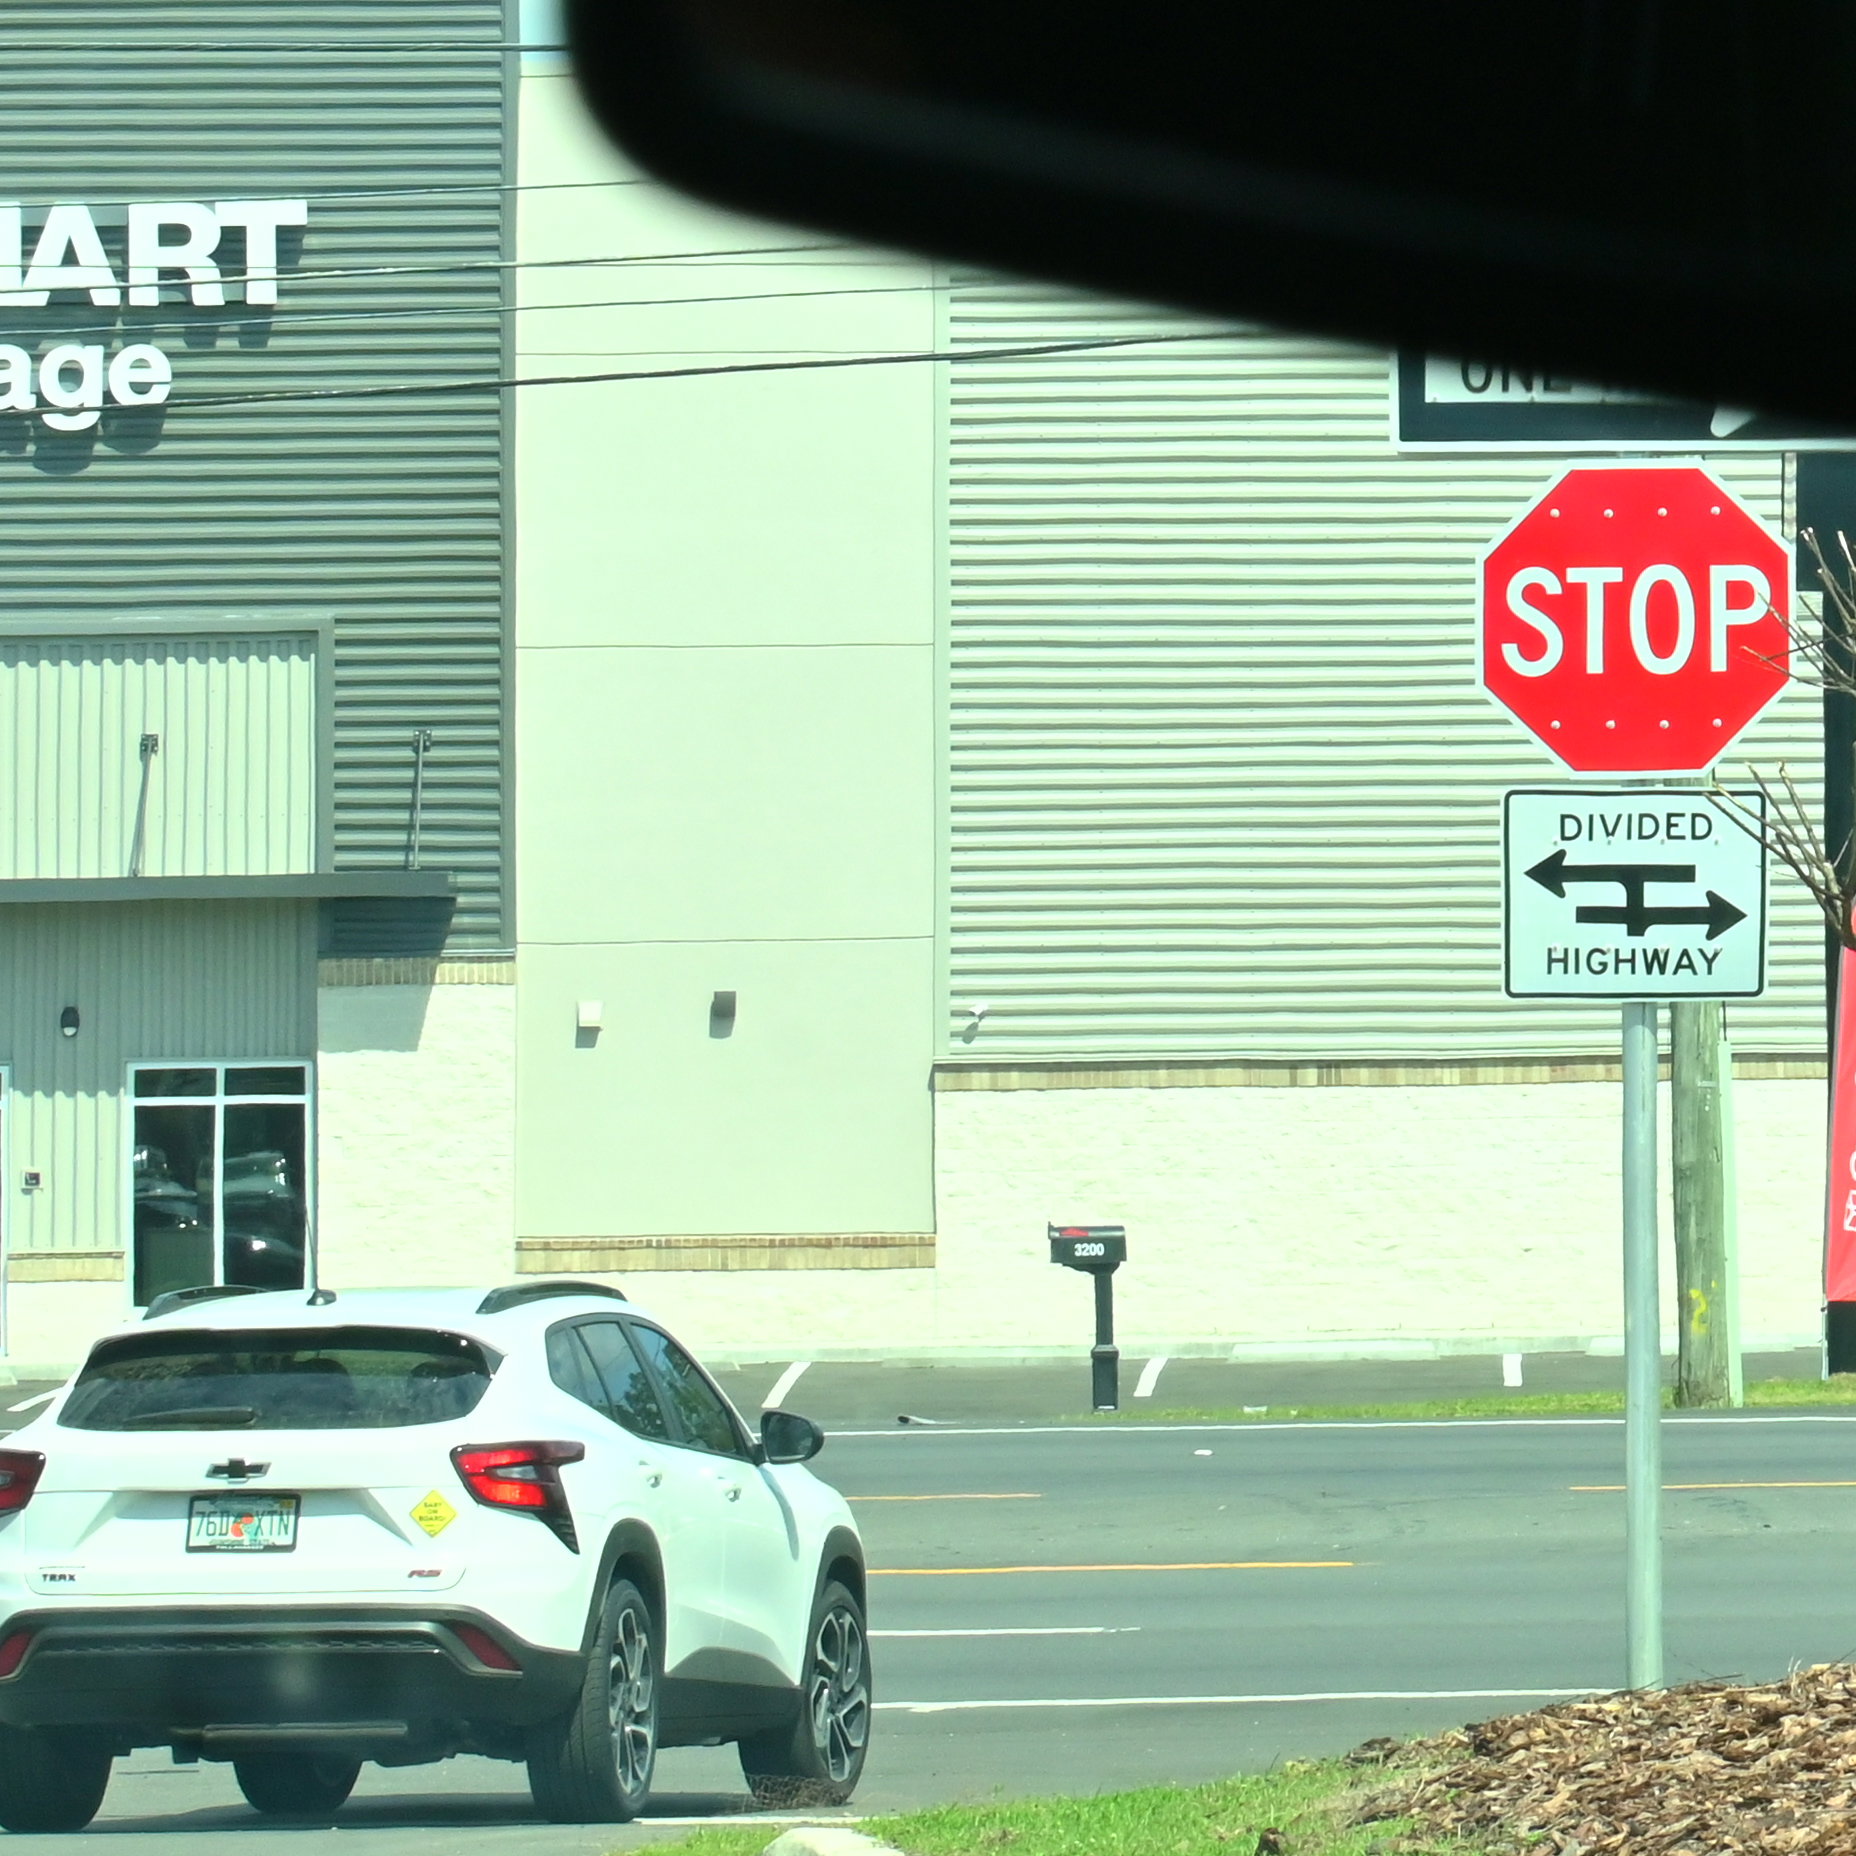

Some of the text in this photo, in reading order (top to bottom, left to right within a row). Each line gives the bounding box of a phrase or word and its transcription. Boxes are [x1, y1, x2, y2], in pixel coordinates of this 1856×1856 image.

[0, 199, 308, 307] ART
[1501, 564, 1771, 678] STOP
[1559, 813, 1713, 842] DIVIDED
[1546, 947, 1723, 976] HIGHWAY
[1074, 1242, 1105, 1257] 3200
